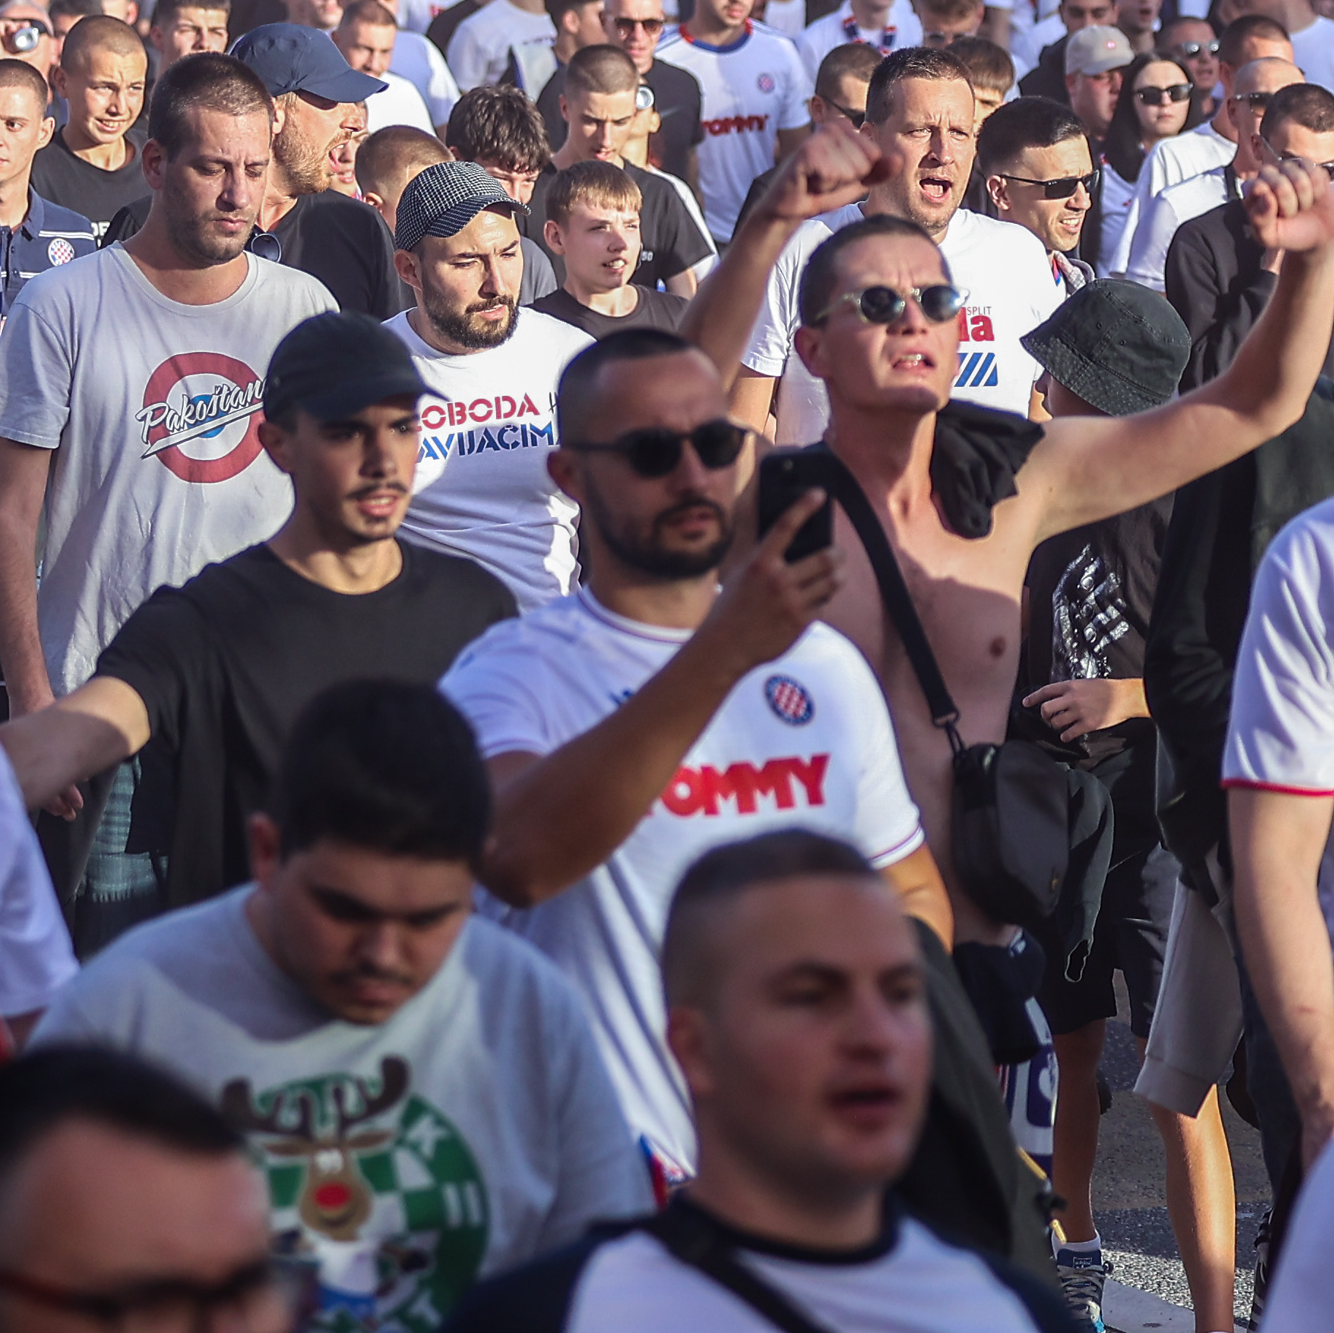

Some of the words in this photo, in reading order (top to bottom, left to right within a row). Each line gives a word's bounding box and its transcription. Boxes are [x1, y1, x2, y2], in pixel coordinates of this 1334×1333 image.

[967, 306, 992, 316] SPLIT
[417, 393, 540, 432] OBODA
[416, 421, 561, 464] AVIJAČIM
[649, 752, 831, 817] OMMY
